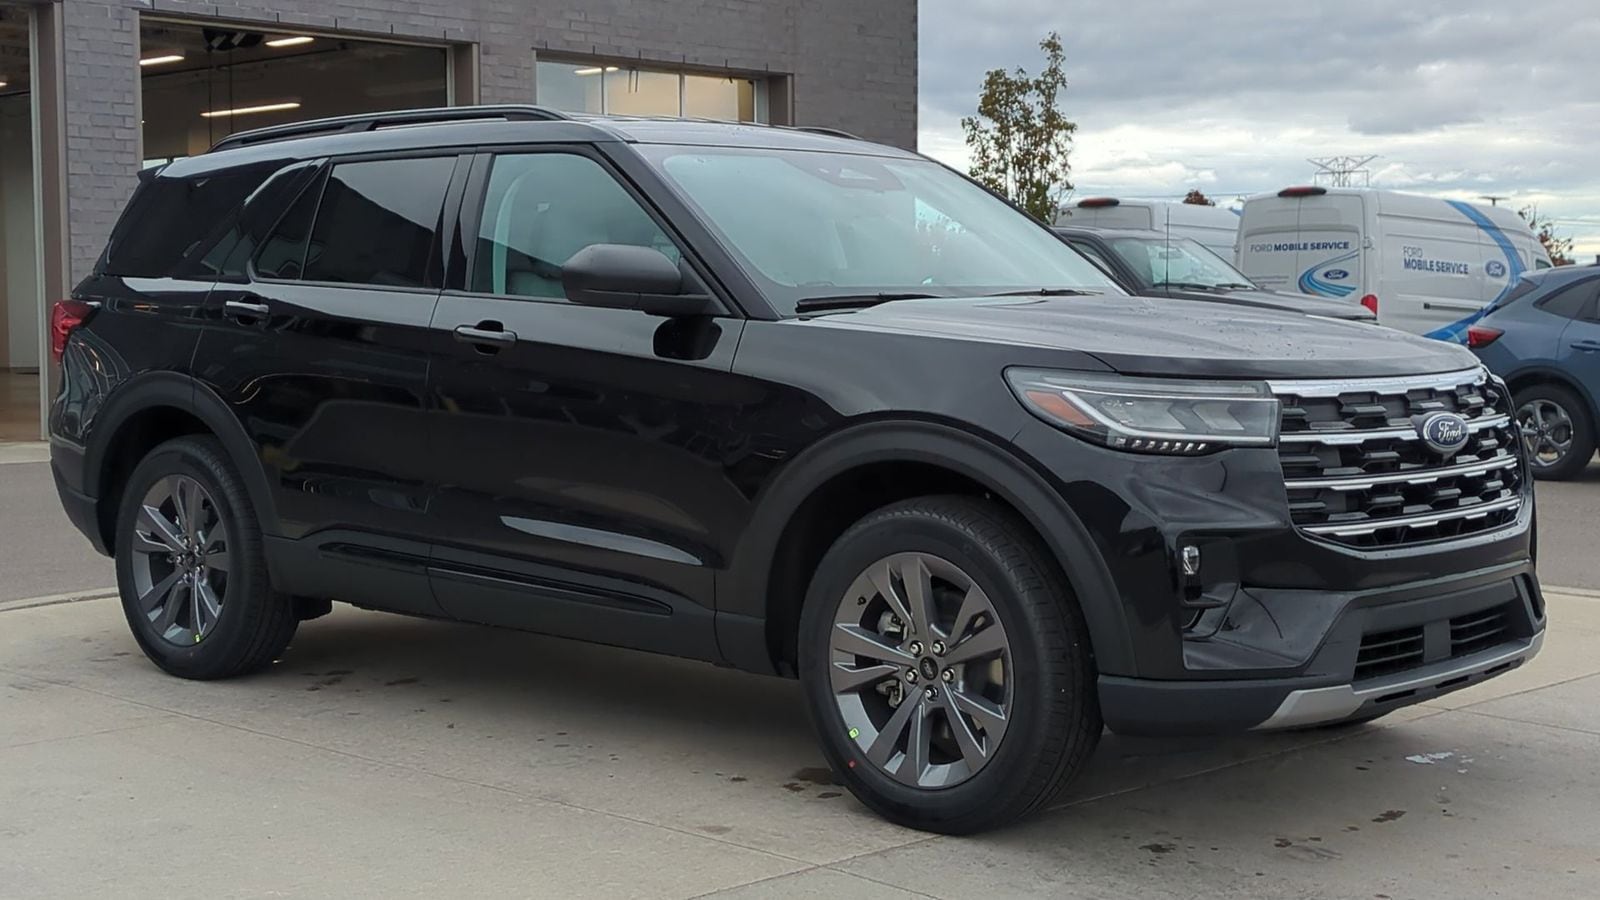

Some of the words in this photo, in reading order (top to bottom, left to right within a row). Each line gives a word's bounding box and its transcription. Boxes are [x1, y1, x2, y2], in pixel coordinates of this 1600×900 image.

[1250, 243, 1272, 252] FORD
[1274, 243, 1308, 251] MOBILE
[1310, 241, 1349, 250] SERVICE
[1403, 246, 1423, 258] FORD
[1404, 258, 1434, 272] MOBILE
[1435, 261, 1469, 275] SERVICE
[1437, 420, 1463, 442] Ford
